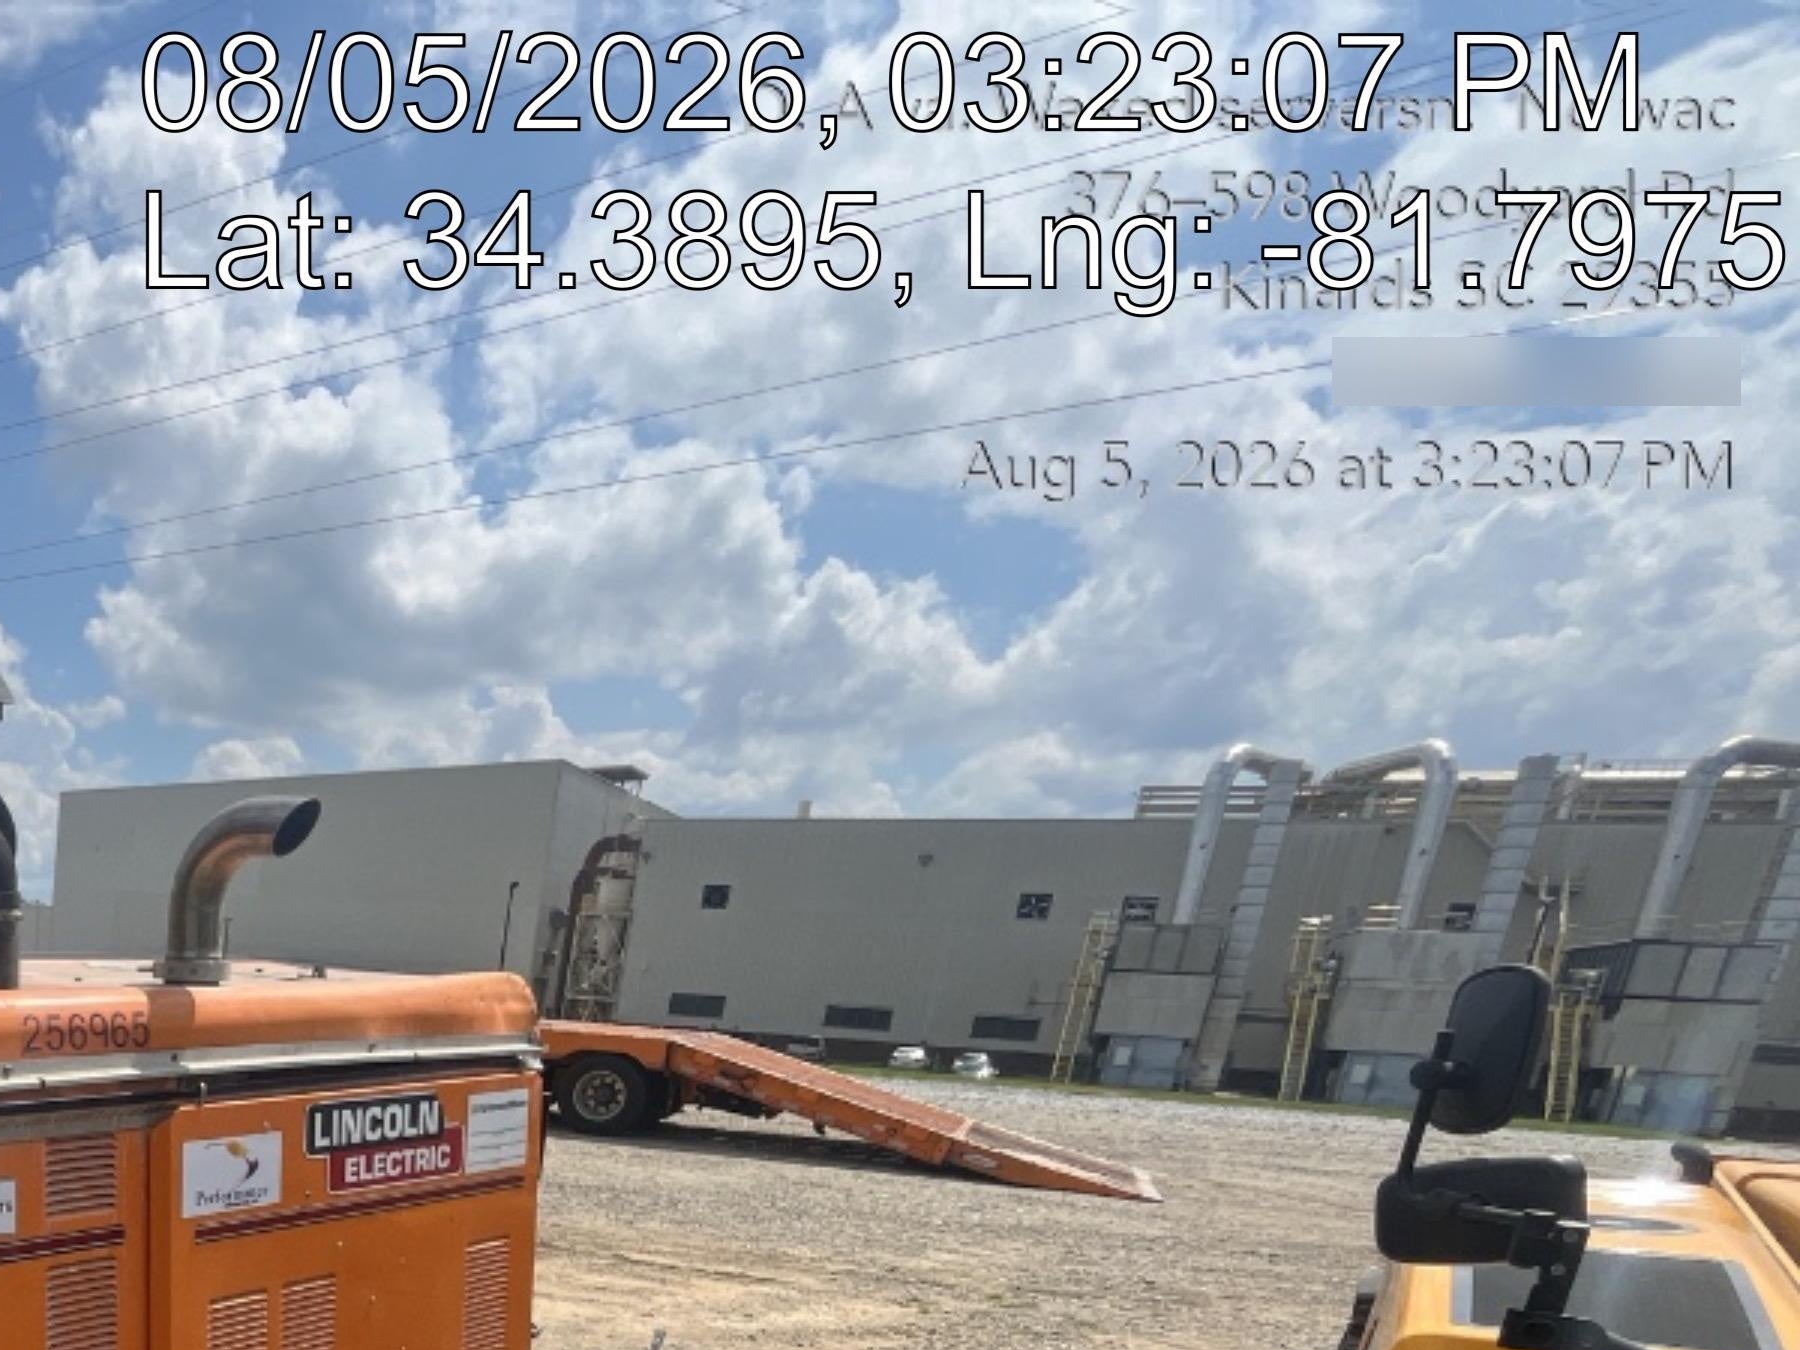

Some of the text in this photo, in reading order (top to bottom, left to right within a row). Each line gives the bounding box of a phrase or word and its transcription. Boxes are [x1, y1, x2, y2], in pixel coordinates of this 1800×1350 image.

[21, 1010, 151, 1054] 256965
[313, 1100, 441, 1149] LINCOLN
[343, 1143, 451, 1184] ELECTRIC
